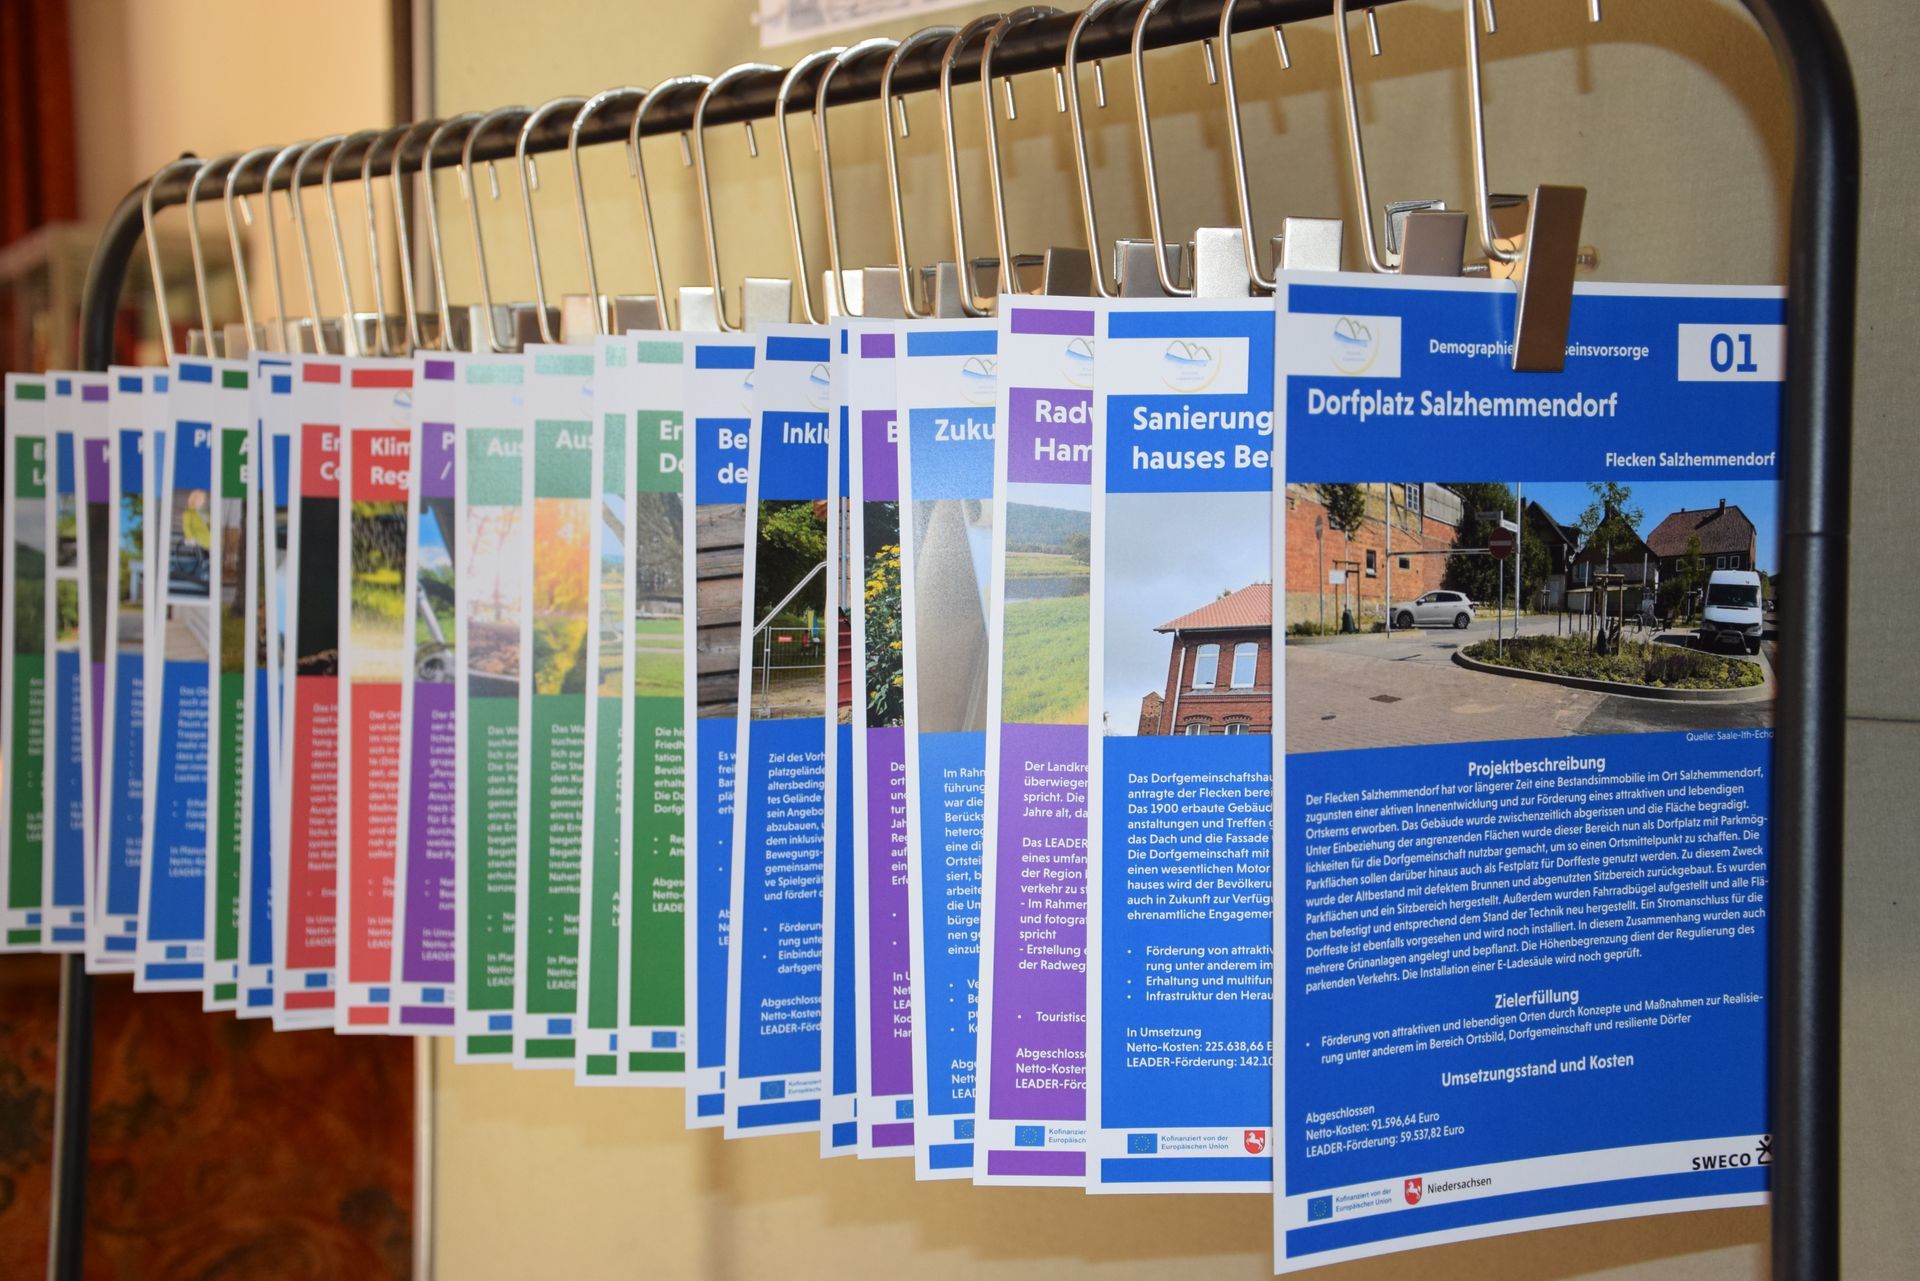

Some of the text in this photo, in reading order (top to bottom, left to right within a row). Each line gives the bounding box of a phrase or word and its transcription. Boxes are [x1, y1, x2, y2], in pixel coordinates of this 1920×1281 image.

[1710, 332, 1757, 372] 01
[1308, 387, 1617, 422] Dorfplatz Salzhemmendorf
[1133, 405, 1273, 435] Sanierung
[1132, 444, 1273, 469] hauses Be
[1605, 451, 1775, 466] Flecken Salzhemmendorf
[1685, 731, 1715, 742] Quelle:
[1024, 760, 1045, 771] Der
[1468, 755, 1605, 779] Projektbeschreibung
[1128, 773, 1148, 783] Das
[1305, 766, 1763, 805] Der Flecken Salzhemmendorf hat vor längerer Zeit eine Bestandsimmobilie im Ort Salzhemmendorf,
[1023, 791, 1085, 803] spricht. Die
[1127, 788, 1174, 800] antragte
[1176, 787, 1196, 798] der
[1199, 787, 1241, 797] Flecken
[1128, 803, 1148, 813] Das
[1150, 803, 1178, 813] 1900
[1181, 803, 1225, 813] erbaute
[1305, 784, 1744, 824] zugunsten einer aktiven Innenentwicklung und zur Förderung eines attraktiven und lebendigen
[1022, 806, 1053, 817] Jahre
[1055, 807, 1071, 818] alt,
[1305, 799, 1748, 839] Ortskerns erworben. Das Gebäude wurde zwischenzeitlich abgerissen und die Fläche begradigt.
[1127, 817, 1265, 831] anstaltungen und Treffen
[1022, 836, 1042, 847] Das
[1127, 832, 1269, 844] das Dach und die Fassade
[1021, 852, 1050, 862] eines
[1127, 847, 1269, 861] Die Dorfgemeinschaft mit
[1021, 867, 1082, 880] der Region
[1020, 883, 1077, 894] verkehr zu
[1019, 928, 1056, 941] spricht
[1026, 943, 1080, 957] Erstellung
[1018, 959, 1038, 969] der
[1494, 988, 1579, 1008] Zielerfüllung
[1126, 1026, 1201, 1039] In Umsetzung
[1126, 1041, 1264, 1052] Netto-Kosten: 225.638,66
[1126, 1056, 1236, 1068] LEADER-Förderung:
[1441, 1054, 1633, 1086] Umsetzungsstand und Kosten
[1305, 1105, 1374, 1124] Abgeschlossen
[1305, 1112, 1439, 1140] Netto-Kosten: 91.596,64 Euro
[1306, 1125, 1464, 1157] LEADER-Förderung: 59.537,82 Euro
[1692, 1152, 1751, 1170] SWECO
[1427, 1177, 1491, 1193] Niedersachsen
